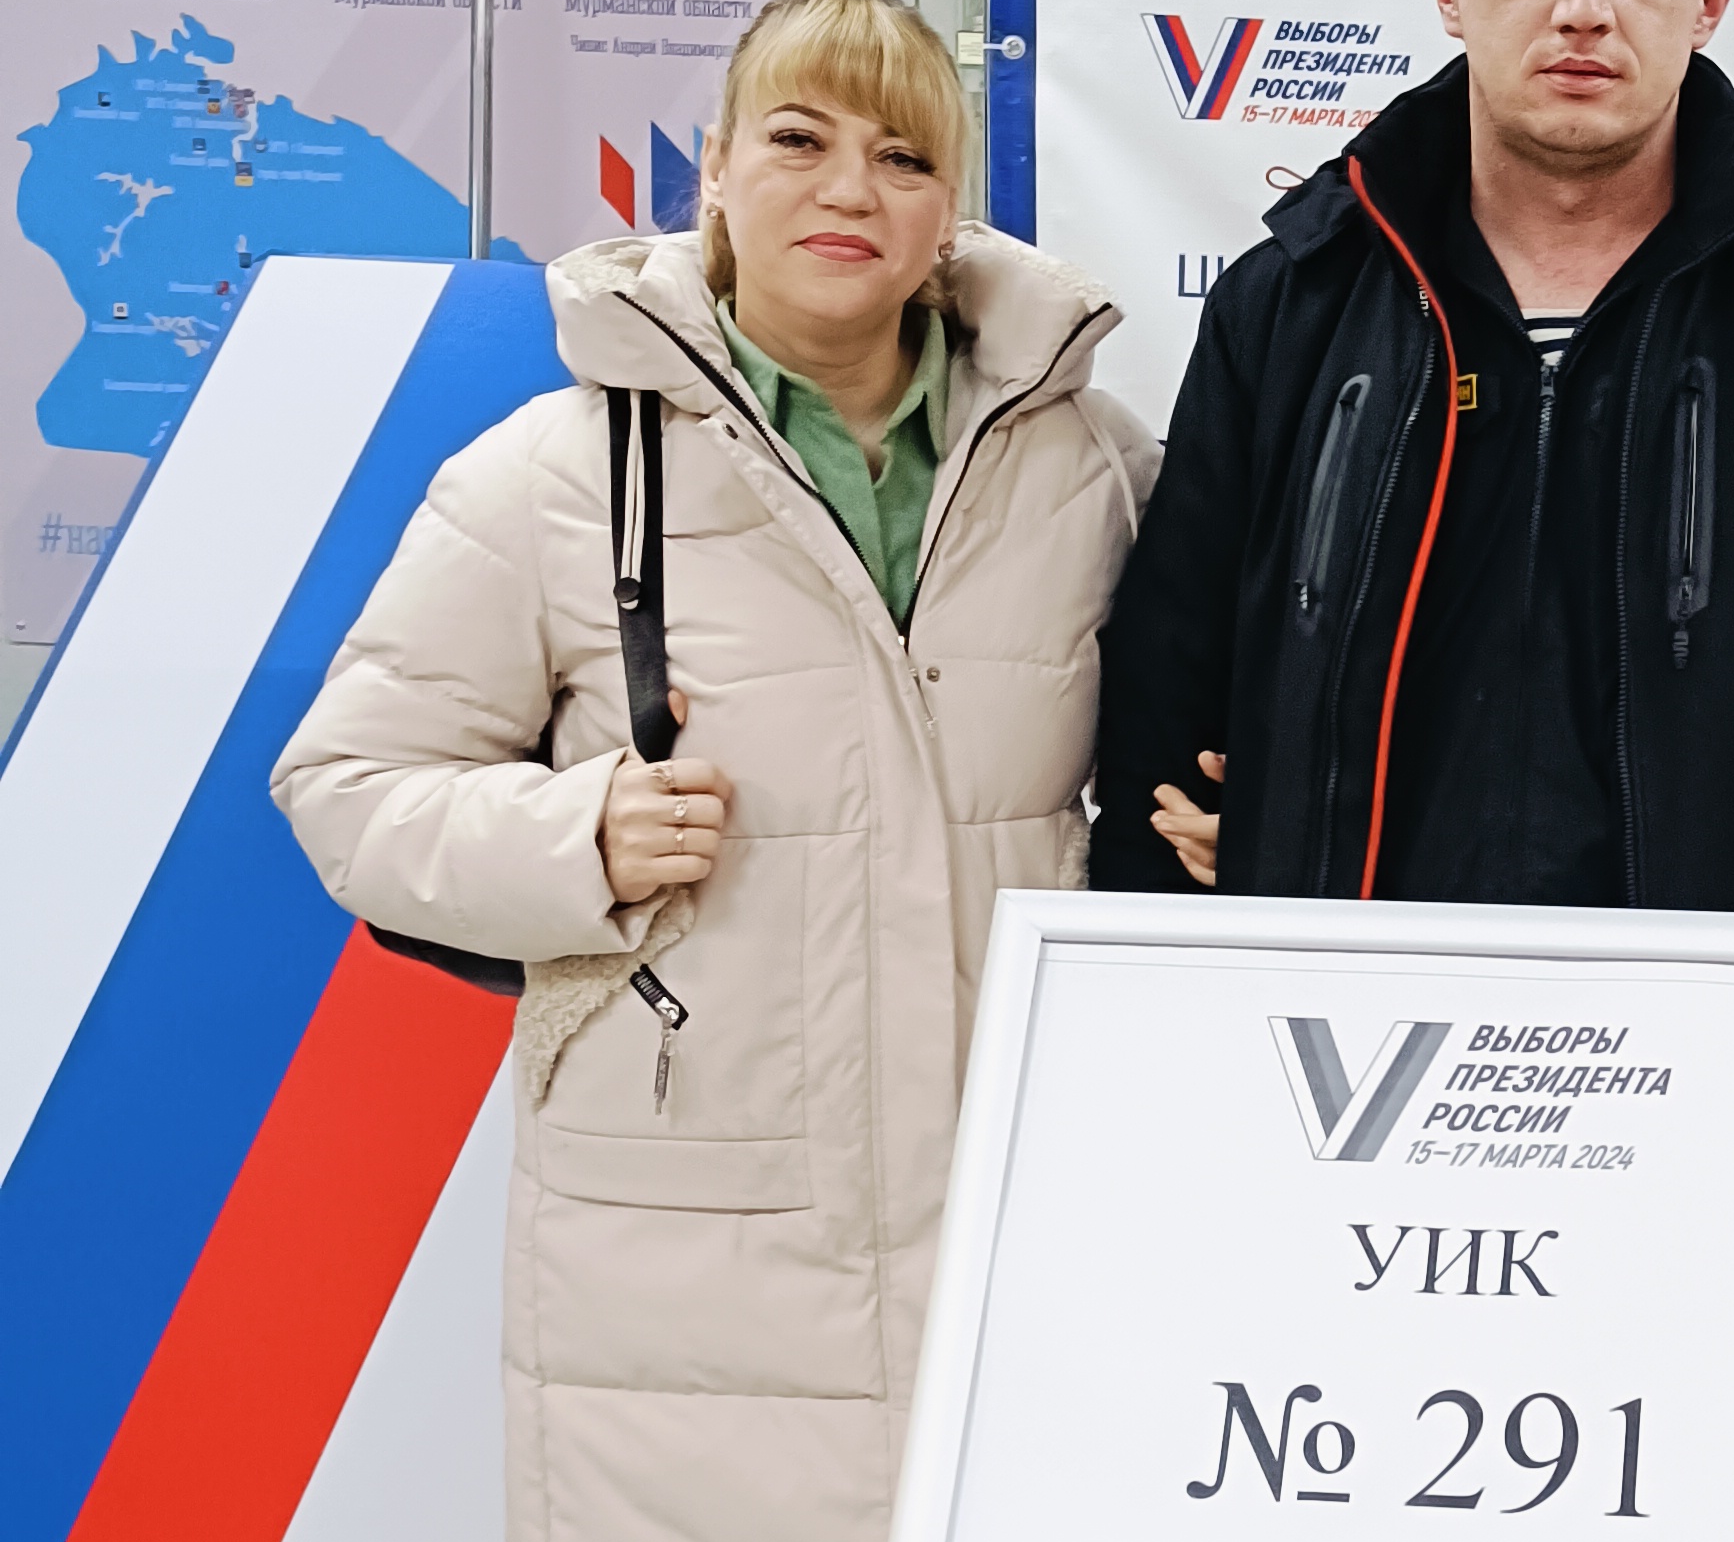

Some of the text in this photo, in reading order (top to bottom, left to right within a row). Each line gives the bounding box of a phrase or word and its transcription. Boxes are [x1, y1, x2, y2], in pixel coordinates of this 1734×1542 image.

[1274, 20, 1383, 45] ВЫБОРЫ
[1262, 49, 1411, 76] ПРЕЗИДЕНТА
[1249, 78, 1347, 102] РОССИИ
[1288, 107, 1346, 127] МАРТА
[1467, 1023, 1629, 1054] ВЫБОРЫ
[1445, 1063, 1673, 1098] ПРЕЗИДЕНТА
[1423, 1102, 1571, 1134] РОССИИ
[1478, 1141, 1569, 1170] МАРТА
[1571, 1143, 1636, 1171] 2024
[1346, 1222, 1560, 1298] УИК
[1404, 1389, 1651, 1519] 291
